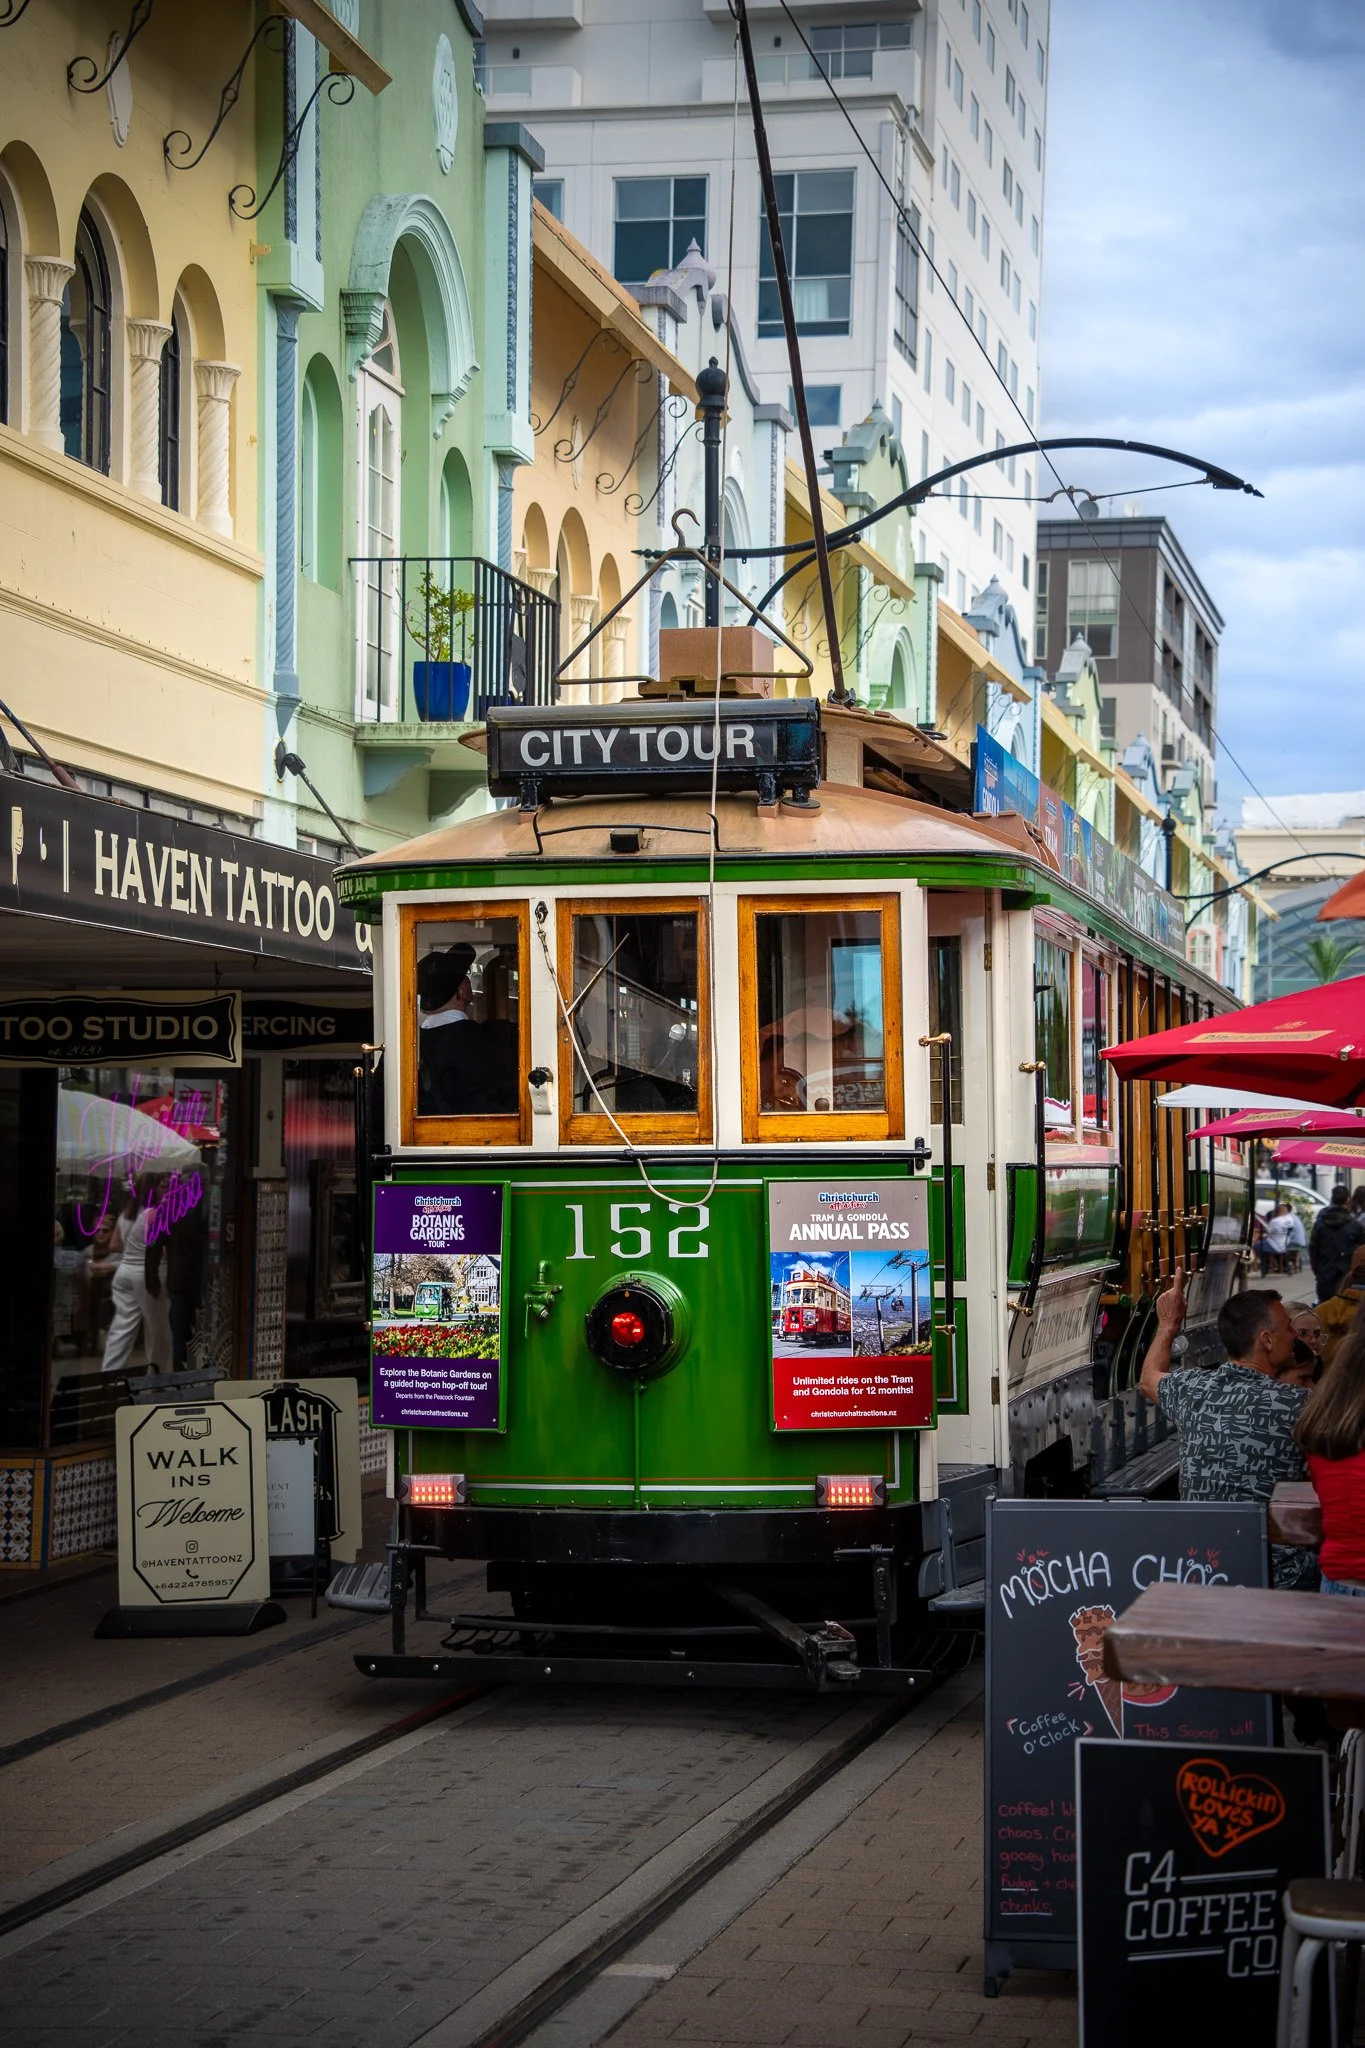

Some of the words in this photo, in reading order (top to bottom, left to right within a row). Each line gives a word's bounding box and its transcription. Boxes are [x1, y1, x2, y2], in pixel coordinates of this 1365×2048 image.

[520, 729, 620, 766] CITY
[629, 723, 755, 763] TOUR
[95, 829, 213, 917] HAVEN
[220, 858, 335, 942] TATTOO
[82, 1015, 218, 1041] STUDIO
[415, 1196, 462, 1206] Christchurch
[818, 1191, 880, 1203] Christchurch
[412, 1214, 464, 1228] BOTANIC
[810, 1213, 835, 1222] TRAM
[837, 1213, 844, 1222] &
[846, 1212, 889, 1222] GONDOLA
[410, 1227, 466, 1241] GARDENS
[565, 1203, 710, 1260] 152
[788, 1222, 864, 1241] ANNUAL
[868, 1221, 910, 1240] PASS
[379, 1367, 407, 1378] Explore
[407, 1368, 419, 1377] the
[420, 1368, 448, 1378] Botanic
[449, 1369, 481, 1379] Gardens
[482, 1371, 492, 1379] on
[792, 1376, 835, 1386] Unlimited
[837, 1375, 859, 1385] rides
[874, 1375, 889, 1384] the
[891, 1375, 914, 1384] Tram
[390, 1380, 414, 1389] guided
[415, 1380, 441, 1389] hop-on
[442, 1381, 469, 1390] hop-off
[470, 1382, 488, 1391] tour!
[792, 1387, 811, 1397] and
[811, 1386, 850, 1396] Gondola
[851, 1386, 864, 1395] for
[866, 1386, 877, 1395] 12
[878, 1385, 914, 1395] months!
[433, 1393, 454, 1401] Peacock
[454, 1394, 475, 1402] Fountain
[400, 1408, 469, 1418] christchurchattractions.nz
[810, 1409, 898, 1418] christchurchattractions.nz
[147, 1446, 239, 1470] WALK
[171, 1474, 212, 1488] INS
[136, 1496, 245, 1529] Welcome
[141, 1554, 243, 1569] @HAVENTATTOONZ
[1000, 1550, 1113, 1619] MOCHA
[1019, 1711, 1067, 1736] Coffee
[1133, 1722, 1170, 1740] This
[1123, 1848, 1178, 1897] C4
[1000, 1872, 1038, 1896] fudge
[1123, 1888, 1278, 1942] COFFEE
